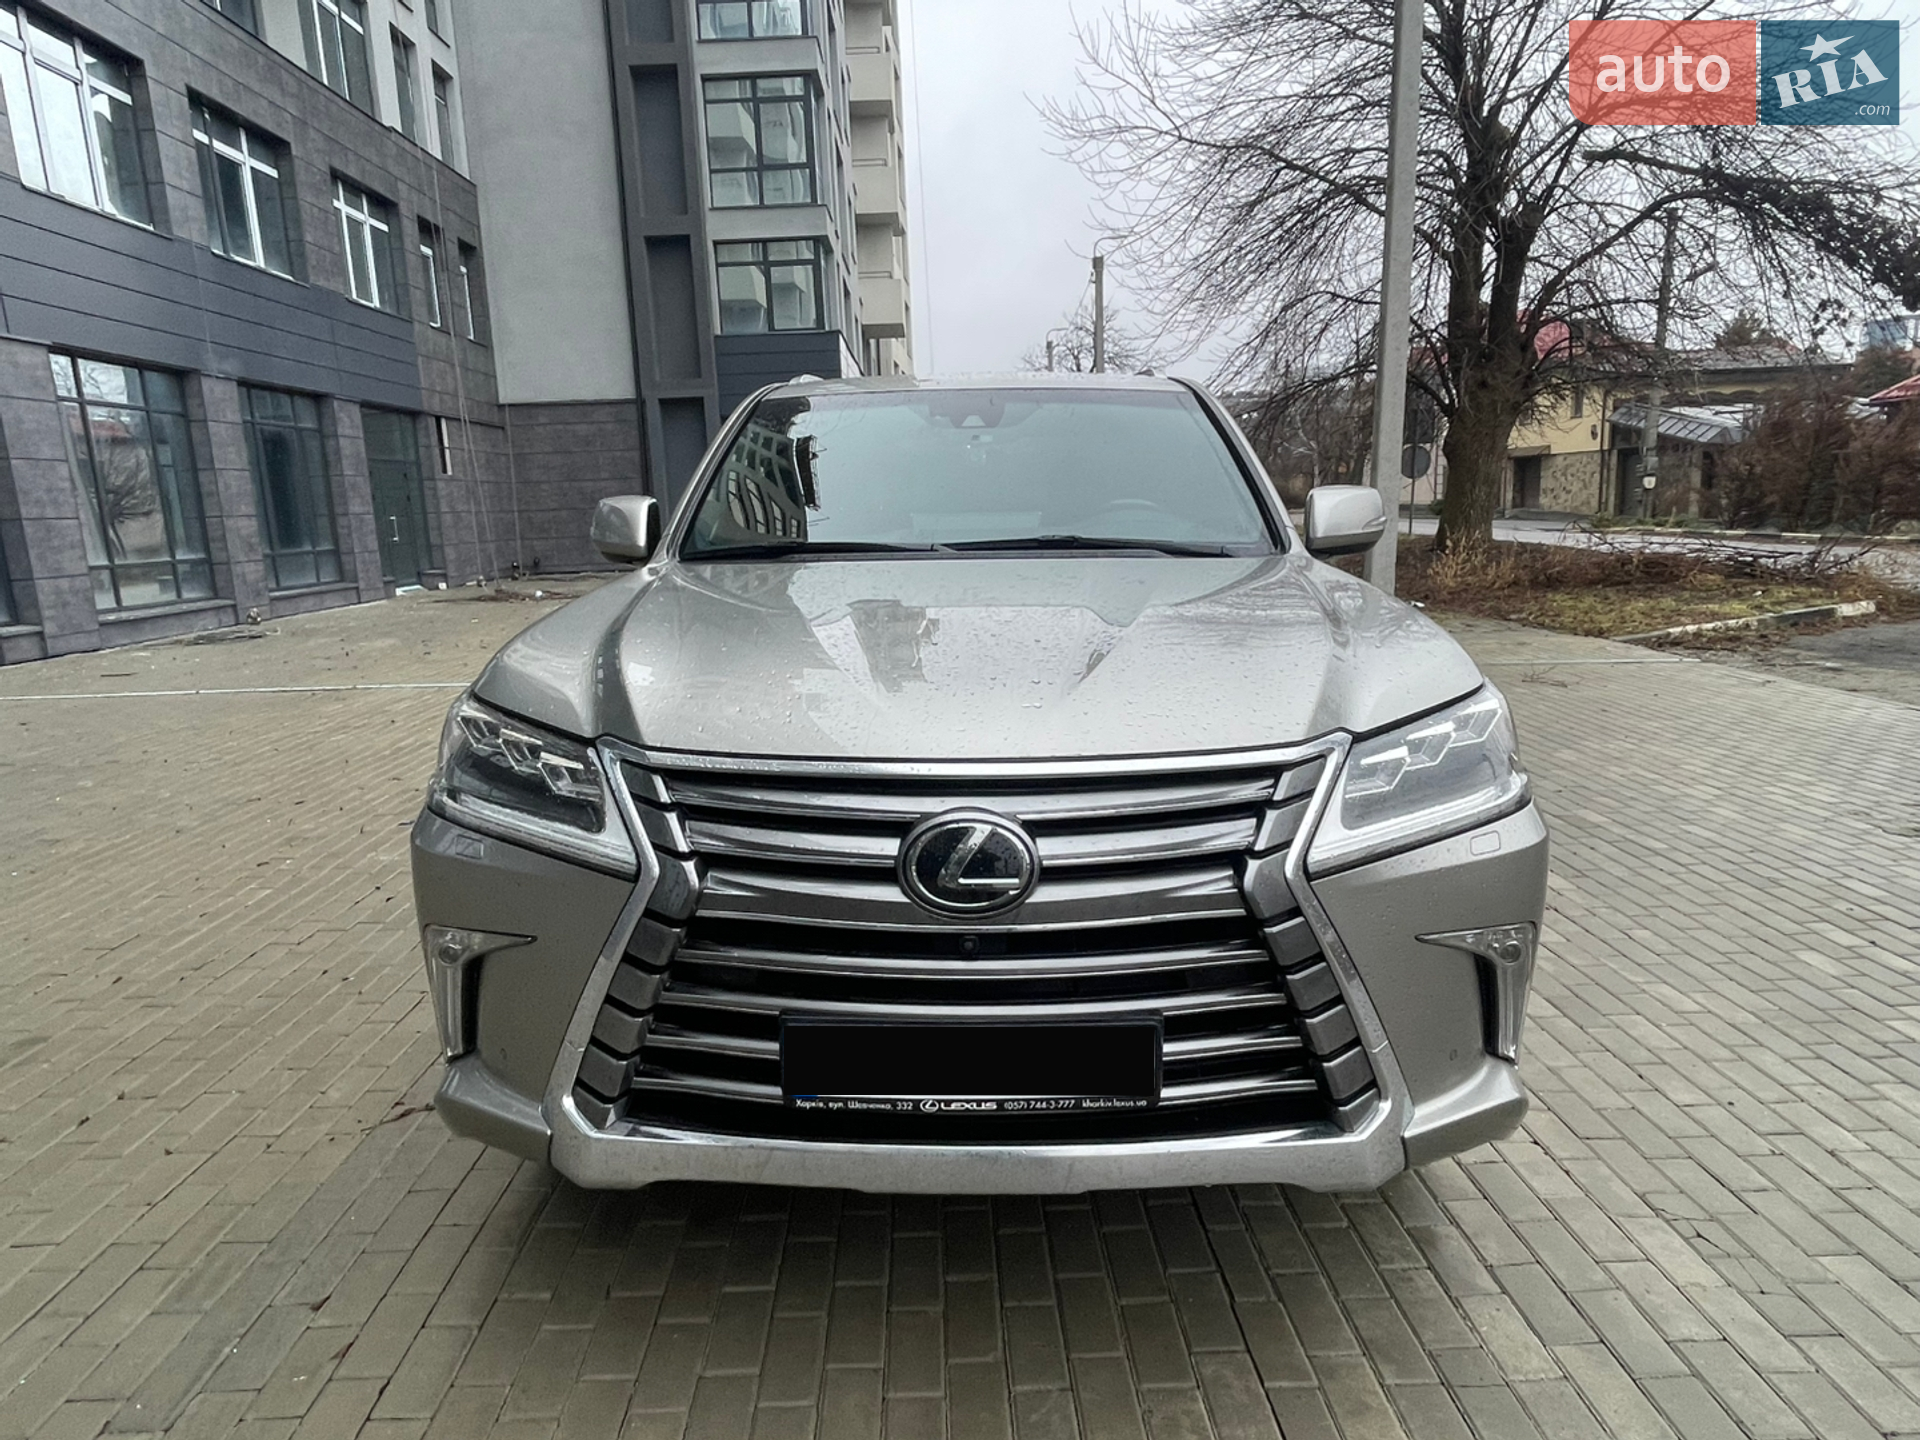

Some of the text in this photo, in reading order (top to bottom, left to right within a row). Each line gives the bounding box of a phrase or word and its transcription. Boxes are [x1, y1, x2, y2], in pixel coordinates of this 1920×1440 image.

[896, 1101, 913, 1111] 332
[941, 1101, 998, 1110] LEXUS
[1004, 1099, 1076, 1110] (057) 744-3-777
[1081, 1098, 1147, 1108] kharkiv.lexus.ua
